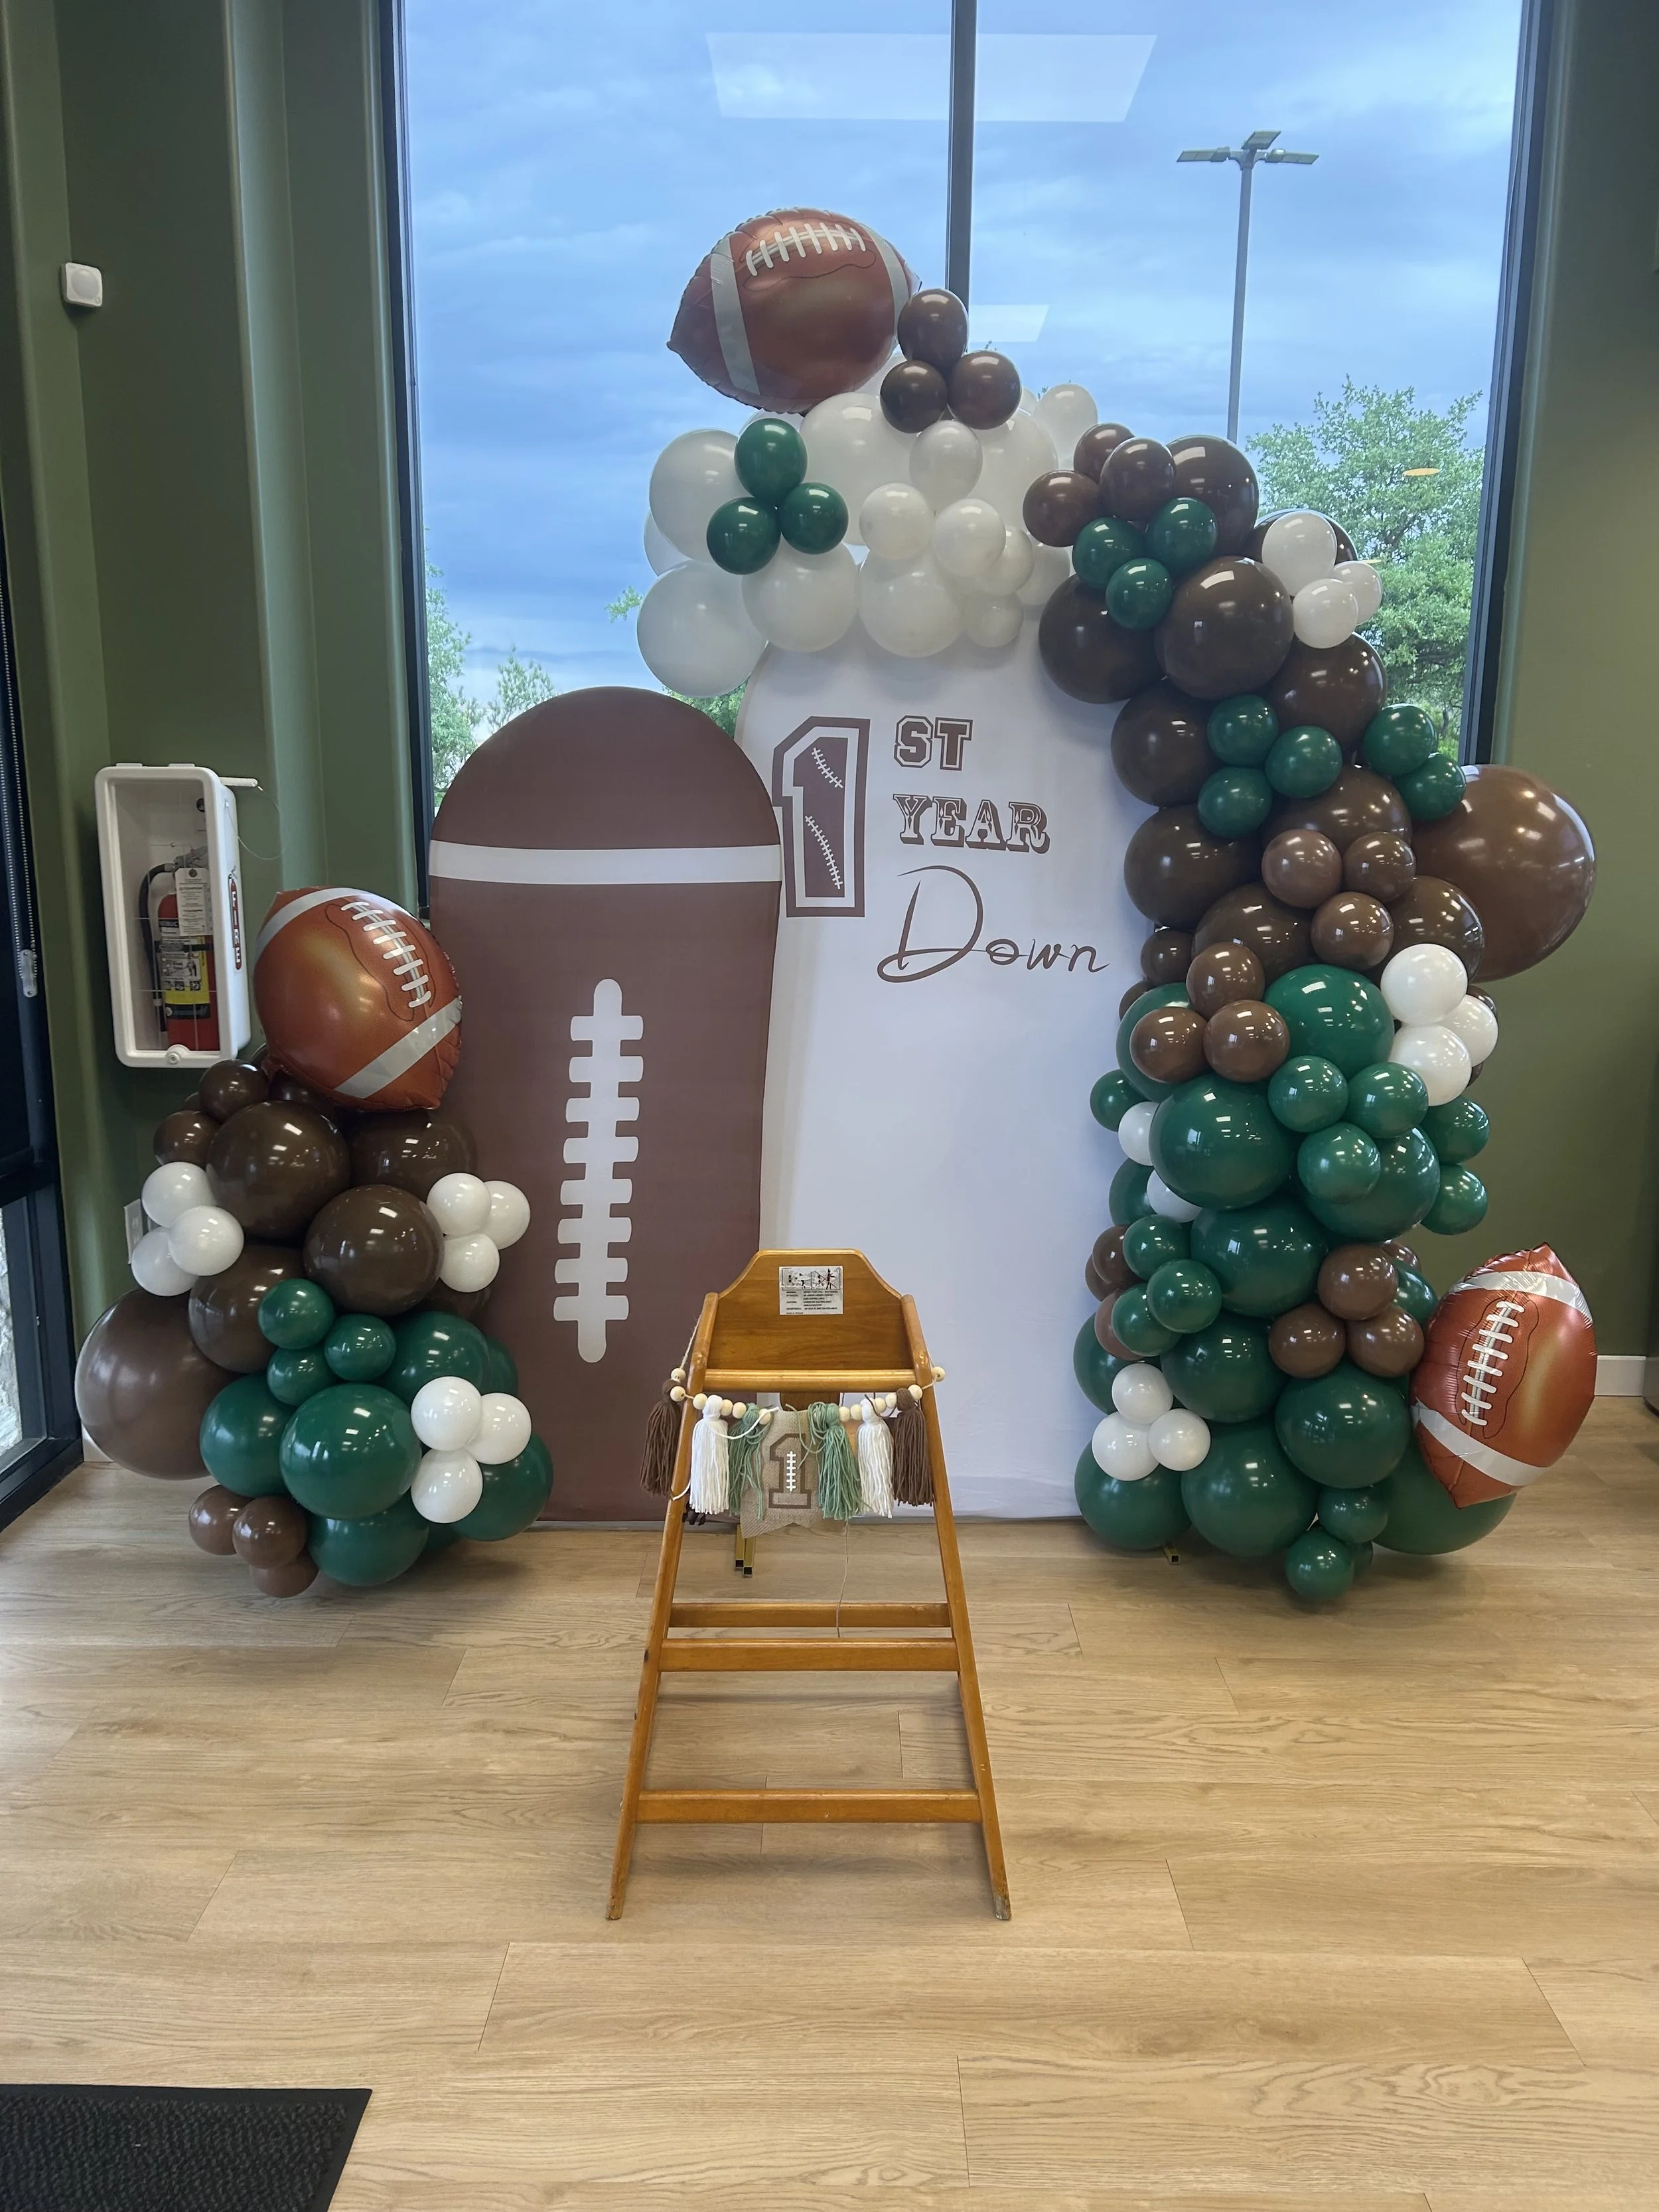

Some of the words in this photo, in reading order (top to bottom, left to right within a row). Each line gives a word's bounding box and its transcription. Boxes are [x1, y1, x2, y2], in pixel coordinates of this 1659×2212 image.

[772, 715, 871, 918] 1
[893, 715, 974, 771] ST
[893, 793, 1050, 854] YEAR
[232, 891, 242, 963] FIRE
[877, 865, 1111, 983] Down
[768, 1433, 812, 1509] 1
